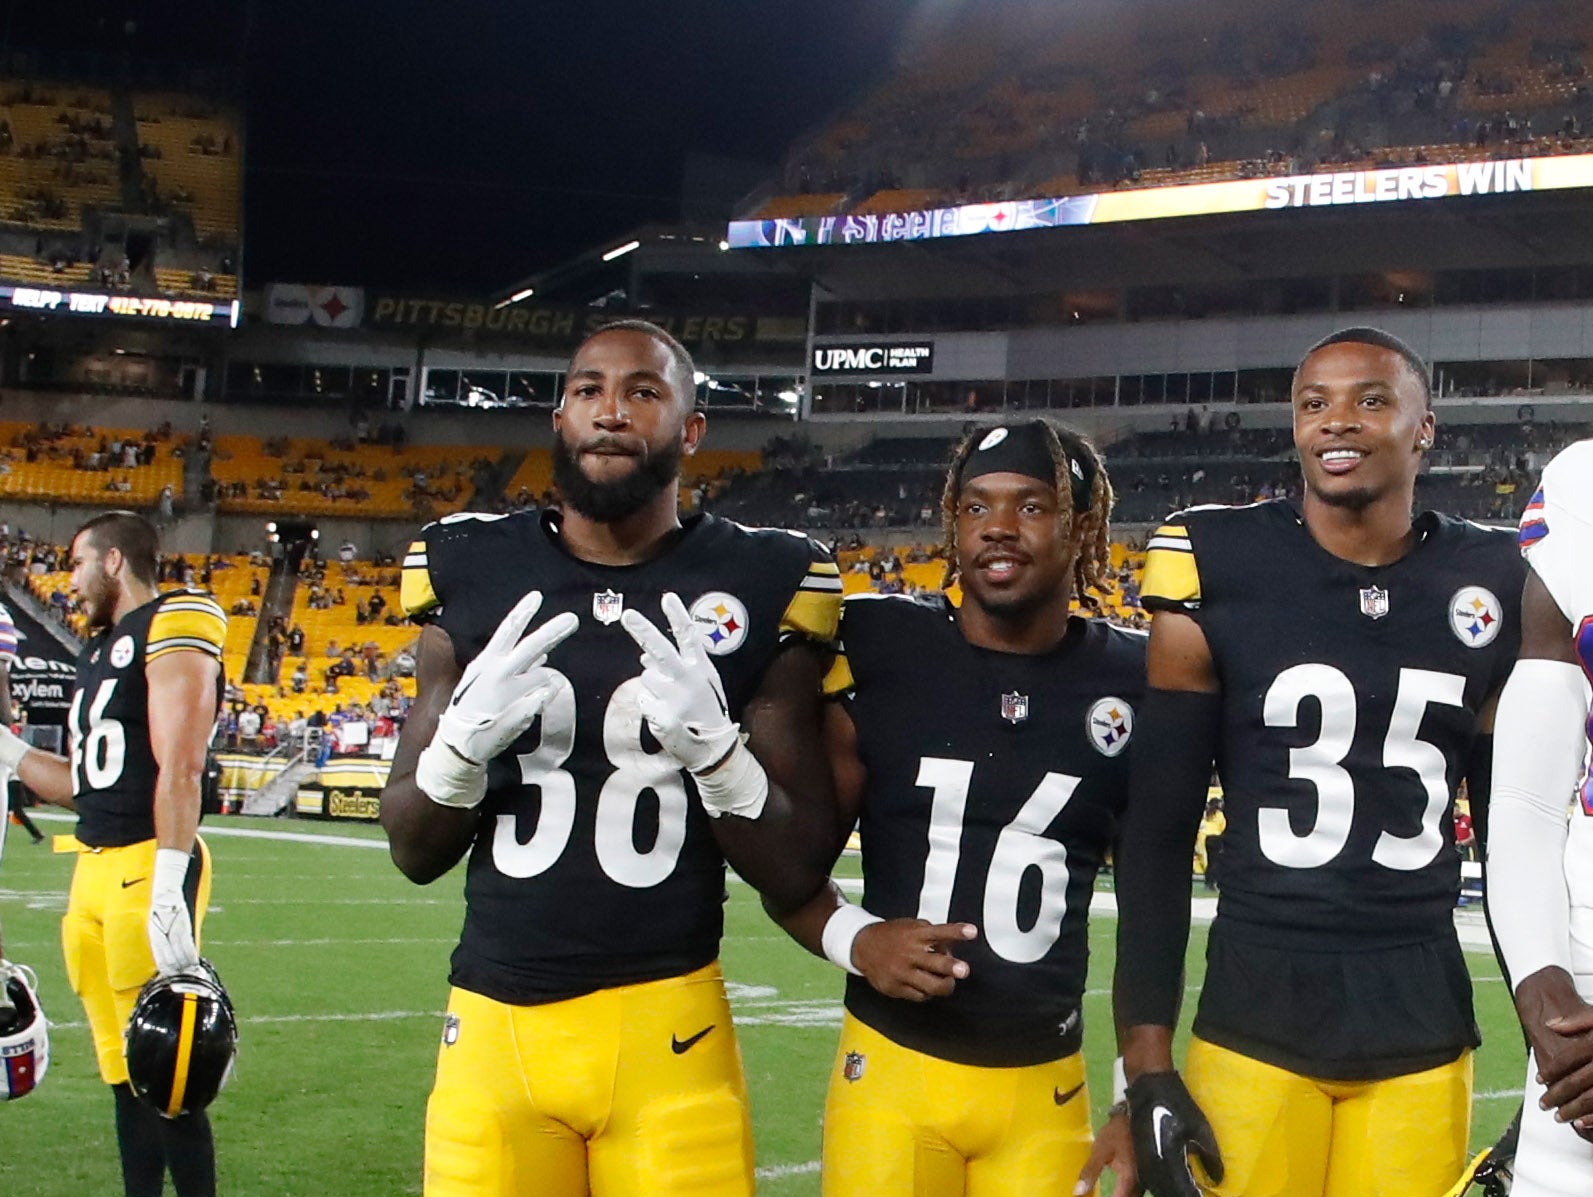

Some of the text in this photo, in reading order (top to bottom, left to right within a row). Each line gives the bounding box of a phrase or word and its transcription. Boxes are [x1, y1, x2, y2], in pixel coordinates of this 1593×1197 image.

[1264, 158, 1533, 209] STEELERS WIN
[69, 293, 109, 313] TEXT
[374, 297, 573, 335] PITTSBURGH
[815, 348, 883, 370] UPMC
[889, 347, 930, 357] HEALTH
[889, 358, 917, 367] PLAN
[12, 680, 64, 702] xylem
[492, 666, 689, 888] 38
[1256, 662, 1467, 871] 35
[329, 790, 381, 819] Steelers
[914, 756, 1083, 964] 16
